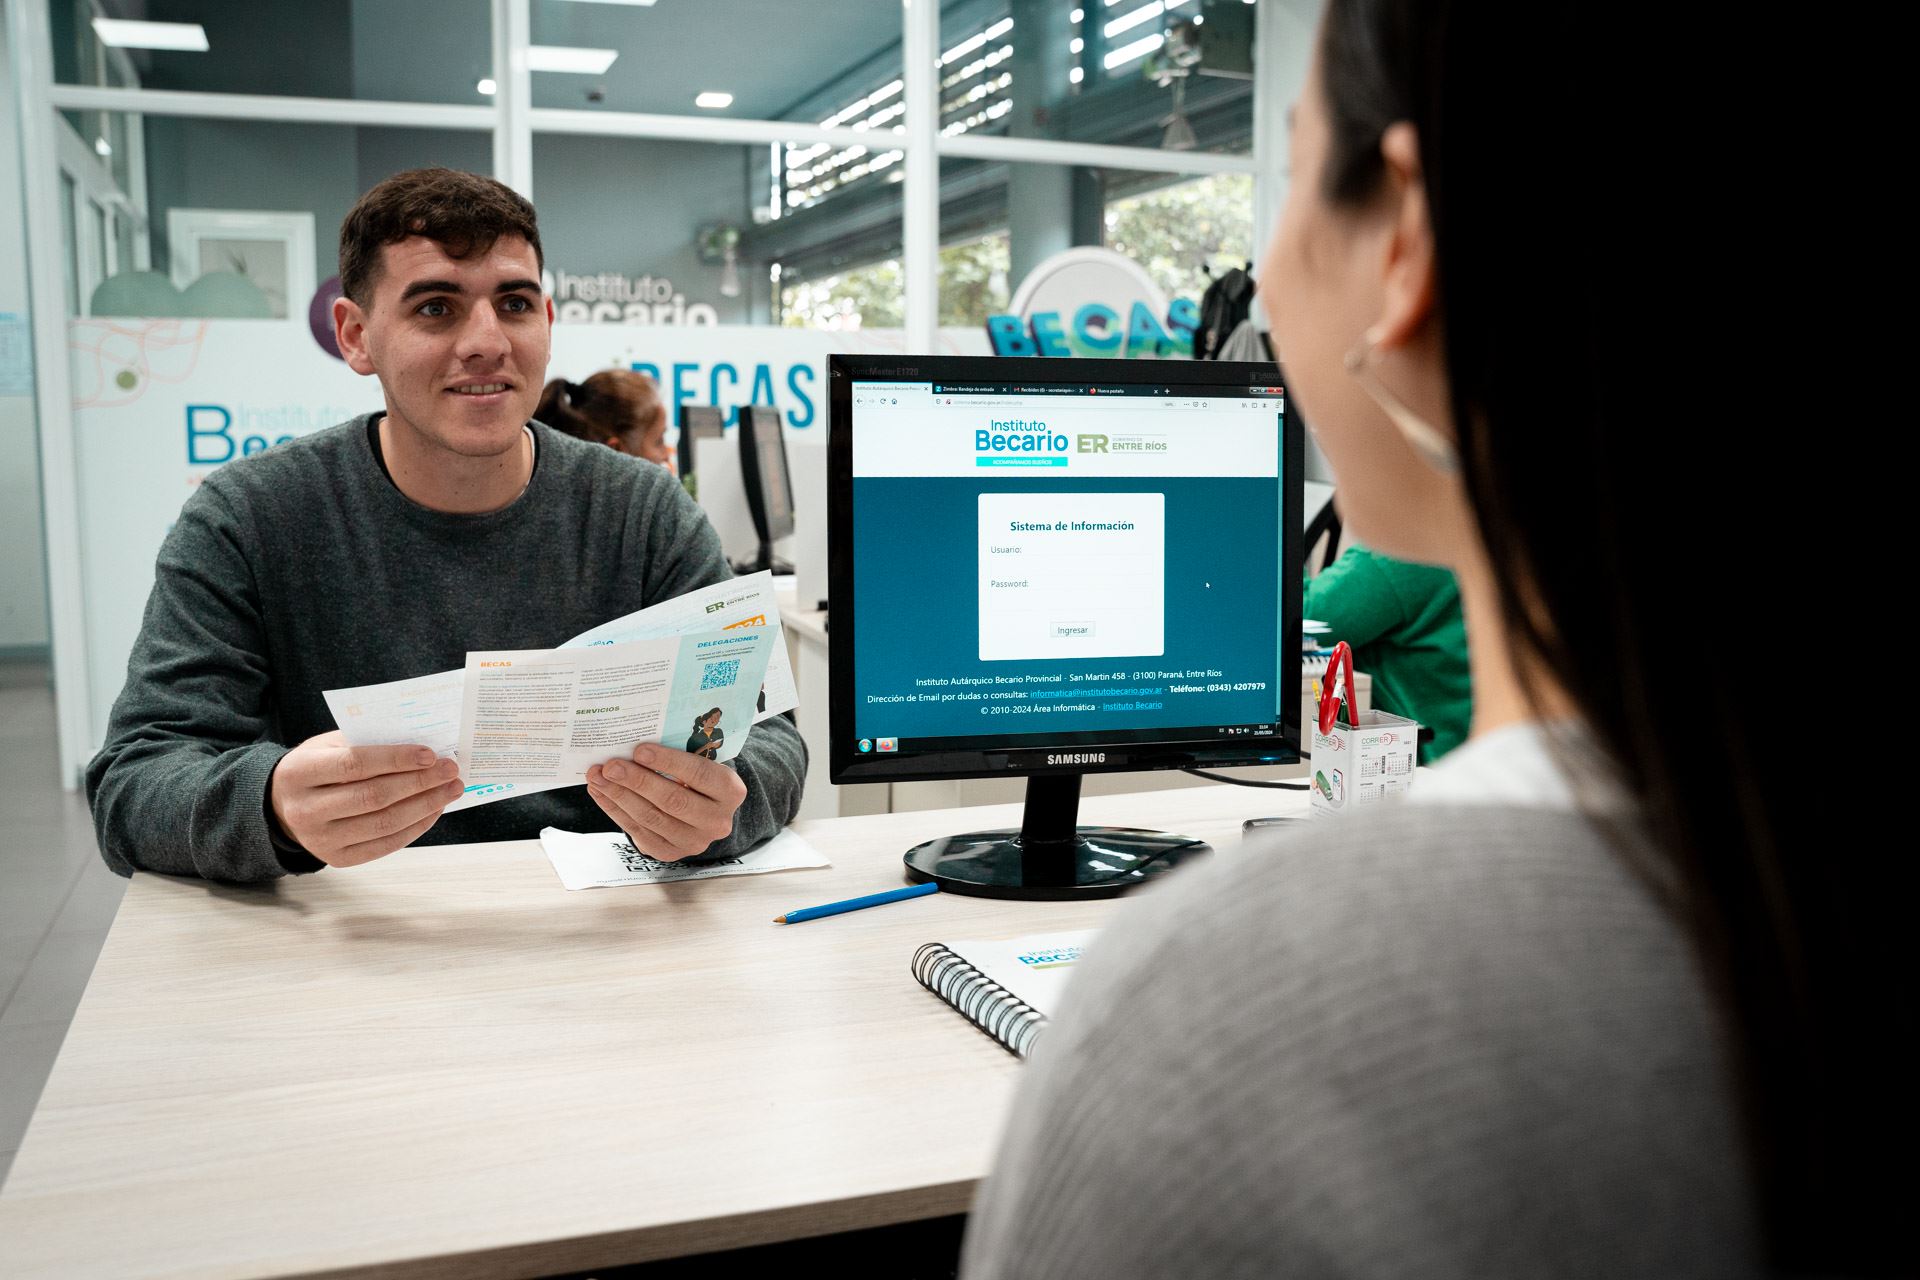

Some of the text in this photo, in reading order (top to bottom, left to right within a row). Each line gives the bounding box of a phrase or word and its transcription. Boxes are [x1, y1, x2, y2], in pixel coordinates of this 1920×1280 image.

[556, 271, 673, 302] Instituto
[549, 292, 718, 326] ecario
[985, 297, 1199, 358] BECAS
[991, 419, 1046, 432] Instituto
[975, 429, 1069, 452] Becario
[1076, 434, 1110, 454] ER
[1112, 440, 1168, 451] ENTRE RÍOS
[1010, 520, 1135, 531] Sistema de Información
[990, 546, 1022, 554] Usuario:
[990, 579, 1029, 588] Password:
[705, 601, 725, 614] ER
[1057, 626, 1089, 637] Ingresar
[697, 634, 759, 648] DELEGACIONES
[916, 678, 949, 686] Instituto
[950, 676, 994, 686] Autárquico
[995, 675, 1024, 684] Becario
[1025, 674, 1062, 683] Provincial
[1069, 674, 1084, 682] San
[1112, 672, 1126, 680] 458
[1132, 671, 1156, 681] (3100)
[1158, 670, 1184, 680] Paraná,
[1186, 670, 1205, 678] Entre
[867, 694, 904, 704] Dirección
[906, 694, 916, 702] de
[918, 692, 940, 702] Email
[942, 693, 956, 702] por
[957, 692, 981, 700] dudas
[990, 690, 1028, 700] consultas:
[1030, 686, 1162, 698] informatica@institutobecario.gov.ar
[1169, 684, 1205, 694] Teléfono:
[1207, 683, 1232, 693] (0343)
[1233, 682, 1266, 691] 4207979
[575, 706, 620, 715] SERVICIOS
[990, 705, 1032, 714] 2010-2024
[1033, 704, 1050, 713] Área
[1052, 702, 1096, 712] Informática
[1102, 702, 1133, 712] Instituto
[1135, 701, 1162, 710] Becario
[1047, 752, 1106, 765] SAMSUNG
